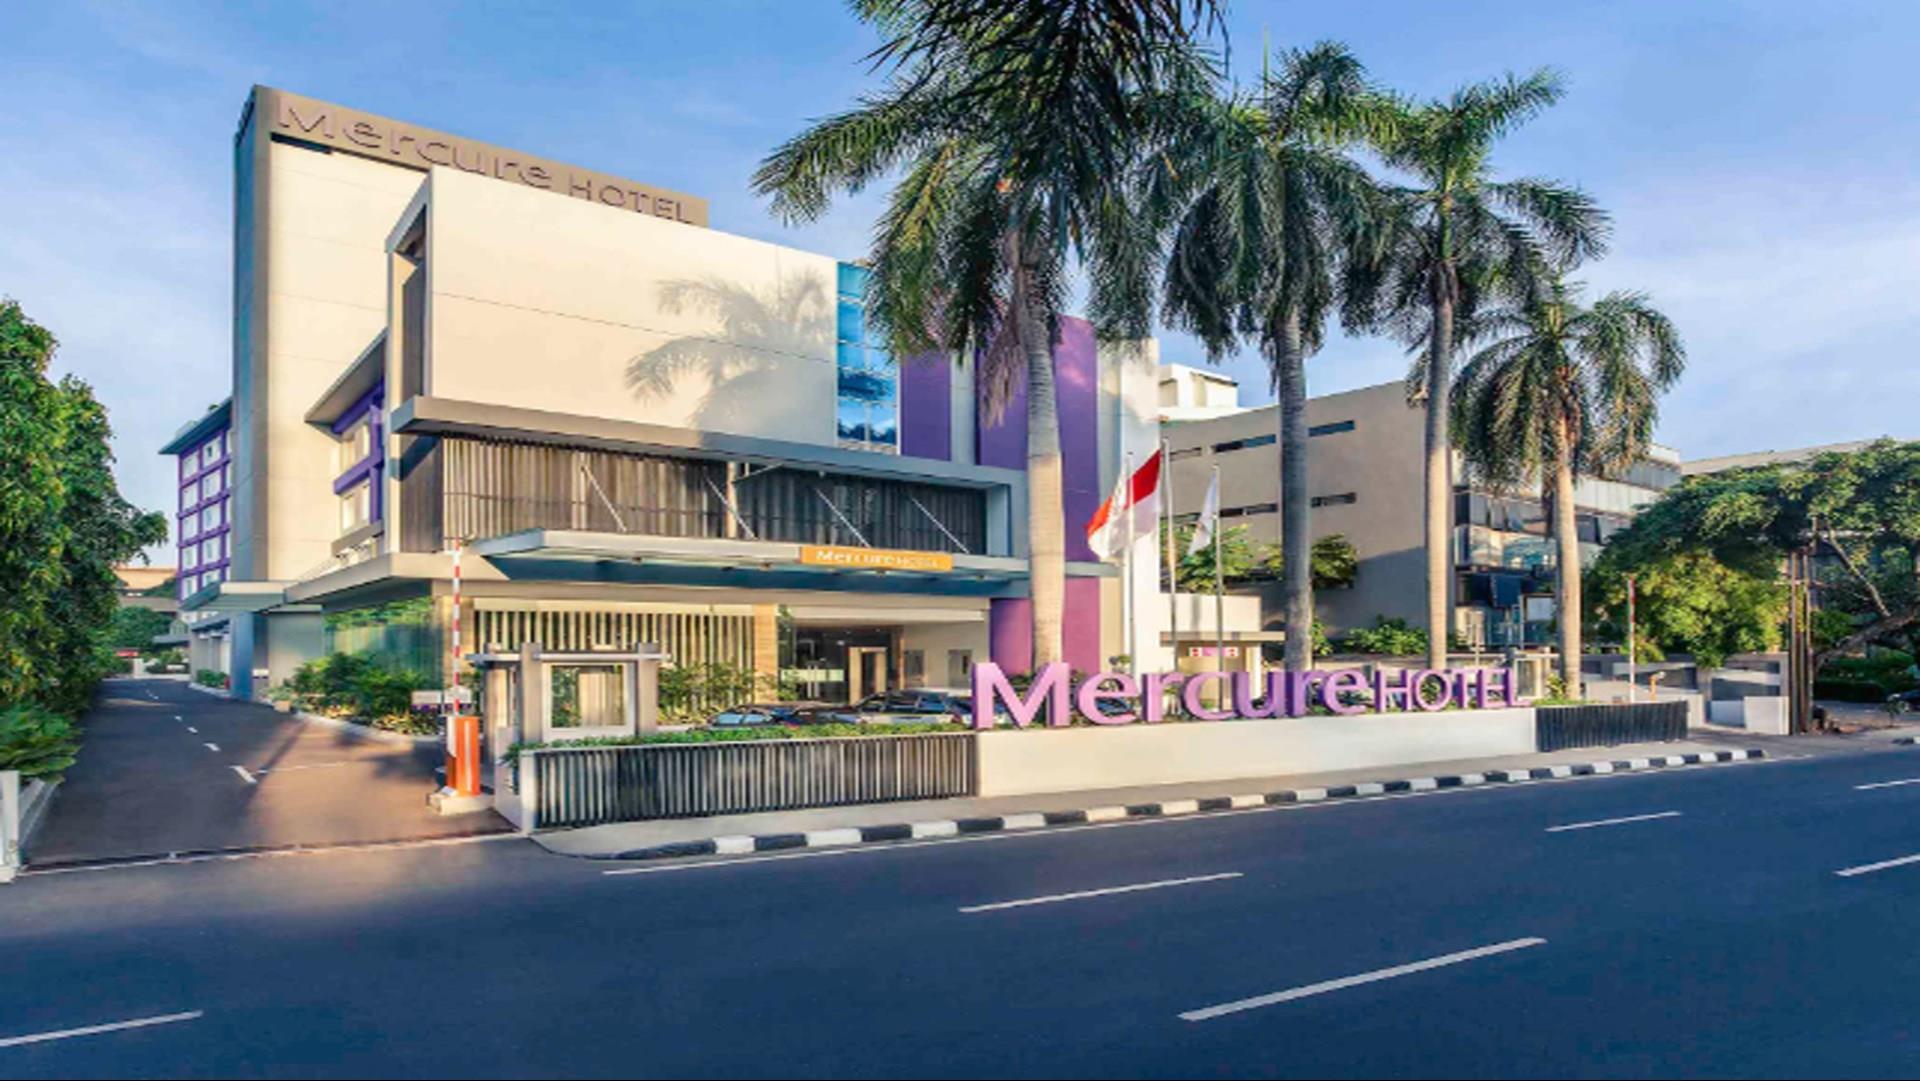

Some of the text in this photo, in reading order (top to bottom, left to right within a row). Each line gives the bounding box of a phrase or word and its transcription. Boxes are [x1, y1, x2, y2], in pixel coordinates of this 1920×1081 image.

[278, 96, 693, 224] Mercure HOTEL
[816, 550, 893, 564] Mercure
[972, 662, 1531, 730] Mercure HOTEL
